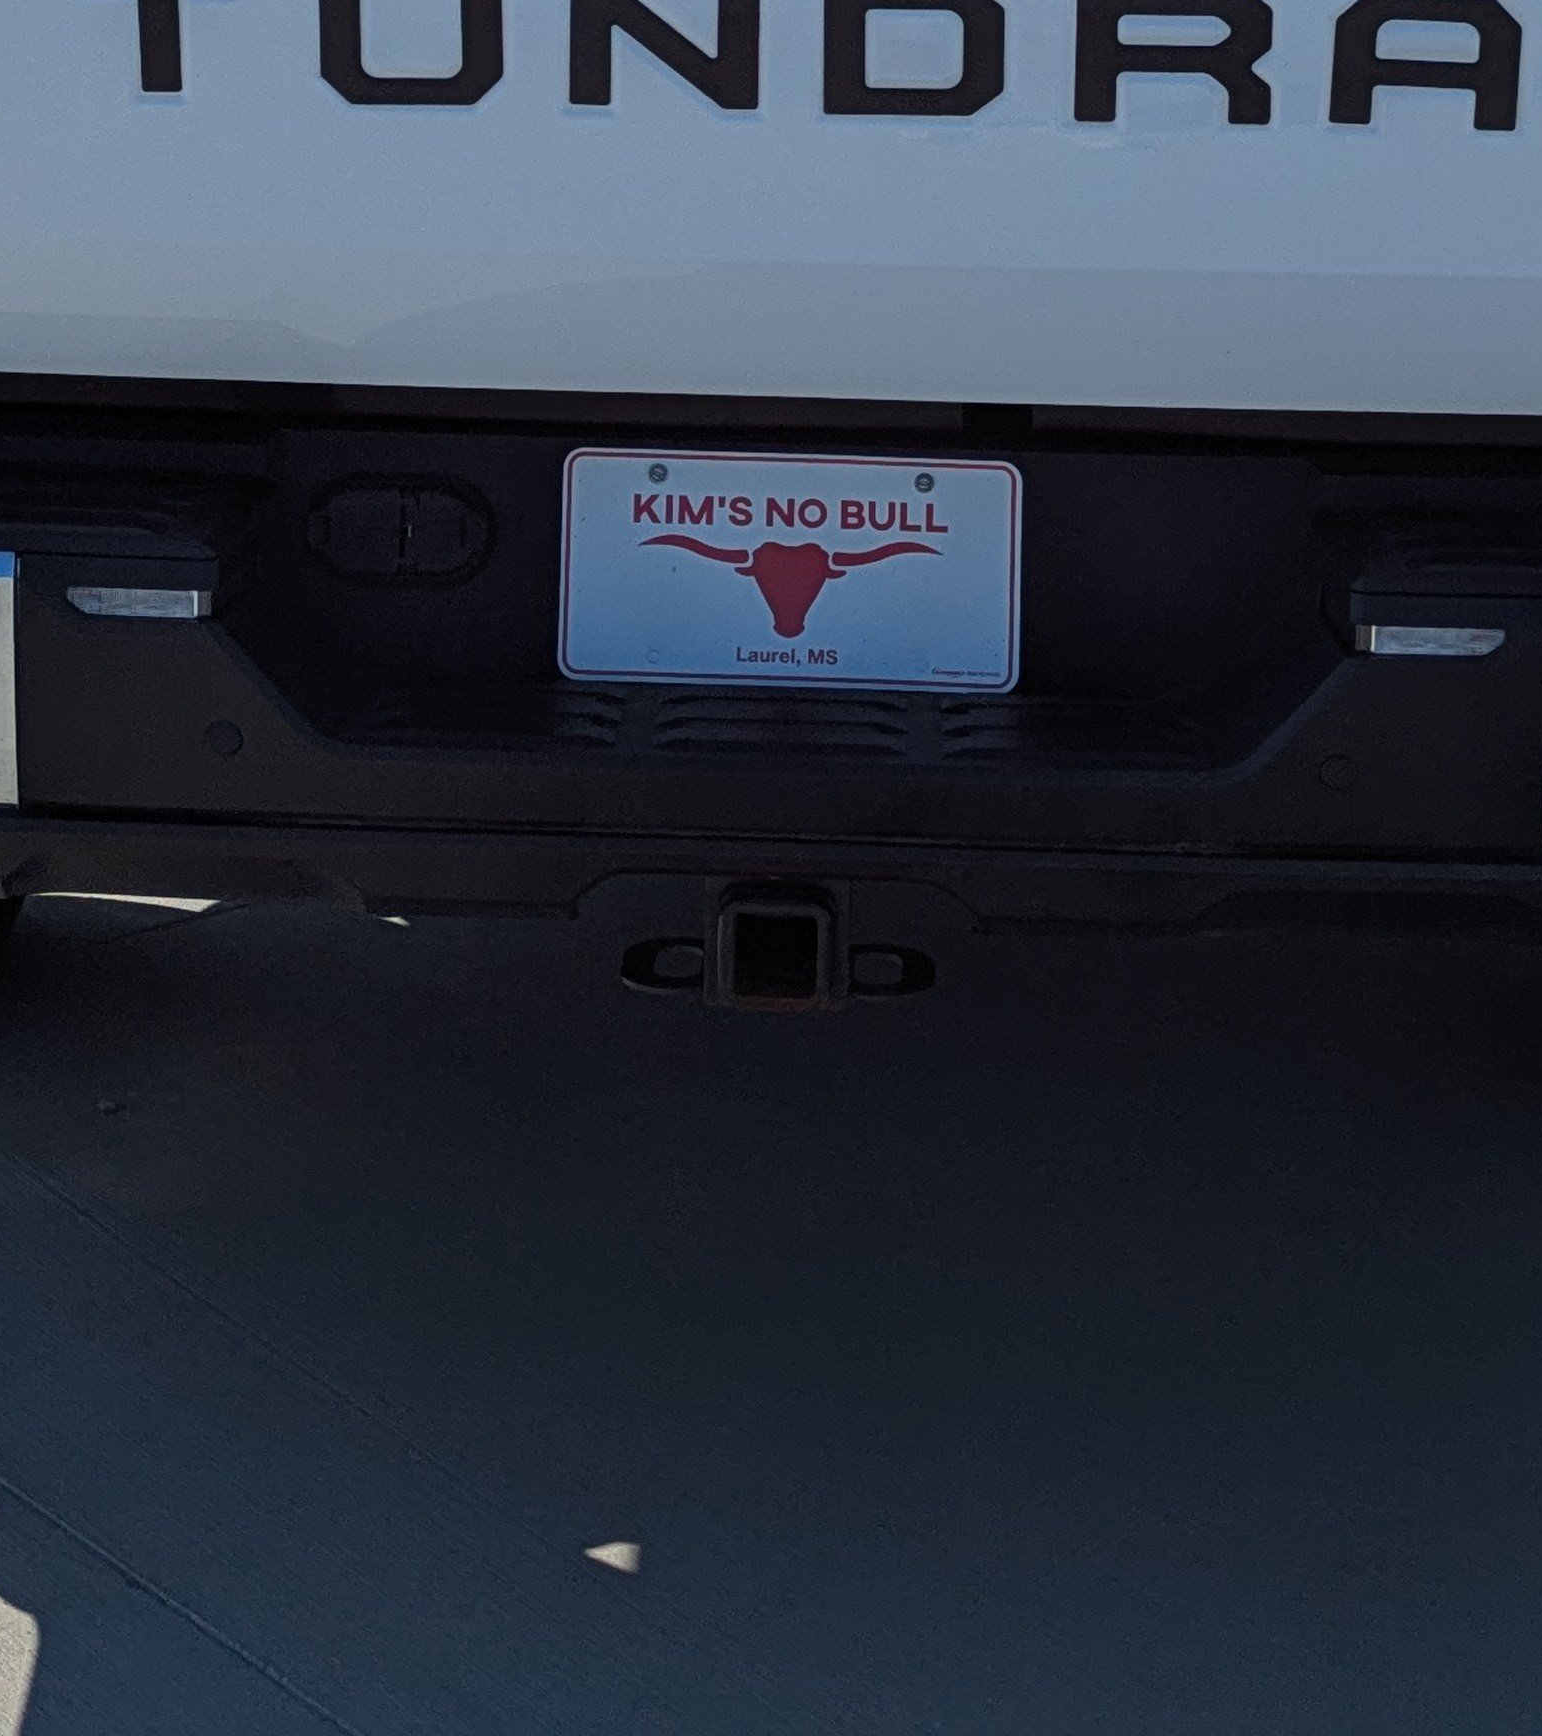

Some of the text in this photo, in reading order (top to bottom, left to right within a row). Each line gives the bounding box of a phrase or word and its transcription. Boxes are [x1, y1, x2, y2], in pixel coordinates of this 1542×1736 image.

[632, 493, 949, 534] KIM'S NO BULL
[736, 646, 839, 668] Laurel, MS
